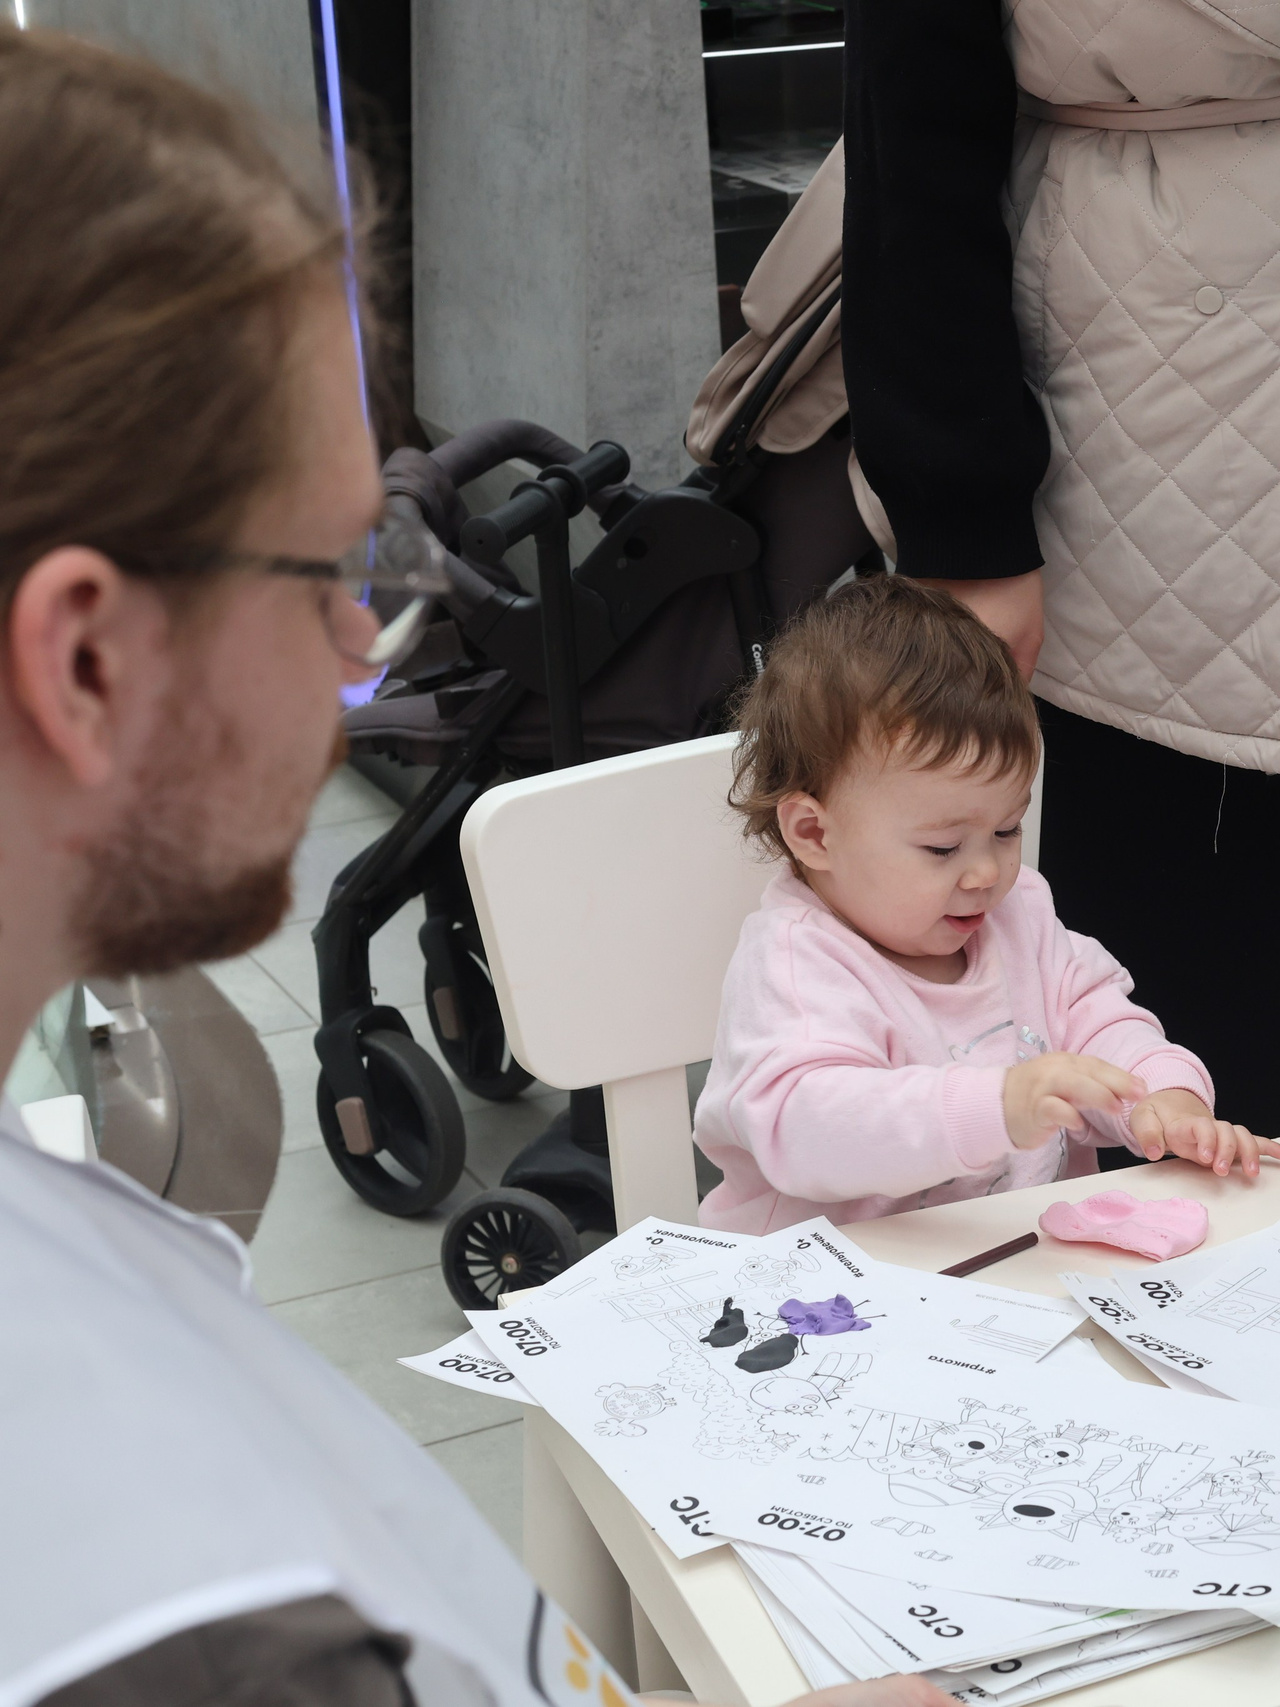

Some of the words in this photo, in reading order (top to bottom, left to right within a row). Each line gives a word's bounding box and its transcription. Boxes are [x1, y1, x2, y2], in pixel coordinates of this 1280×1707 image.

[645, 1236, 664, 1246] 0+
[653, 1229, 738, 1249] отельуовечек
[797, 1238, 811, 1250] 0+
[1140, 1281, 1177, 1309] :00
[1088, 1296, 1130, 1324] :00
[499, 1320, 548, 1356] 07:00
[524, 1316, 553, 1342] СУББОТАМ
[1126, 1334, 1204, 1369] 07:00
[1139, 1332, 1195, 1358] СУББОТАМ
[438, 1358, 515, 1383] 07:00
[928, 1355, 997, 1375] #трикота
[757, 1513, 846, 1542] 07:00
[770, 1505, 833, 1525] СУББОТАМ
[836, 1520, 854, 1530] ПО
[1192, 1582, 1272, 1597] СТС
[908, 1604, 964, 1638] СТС
